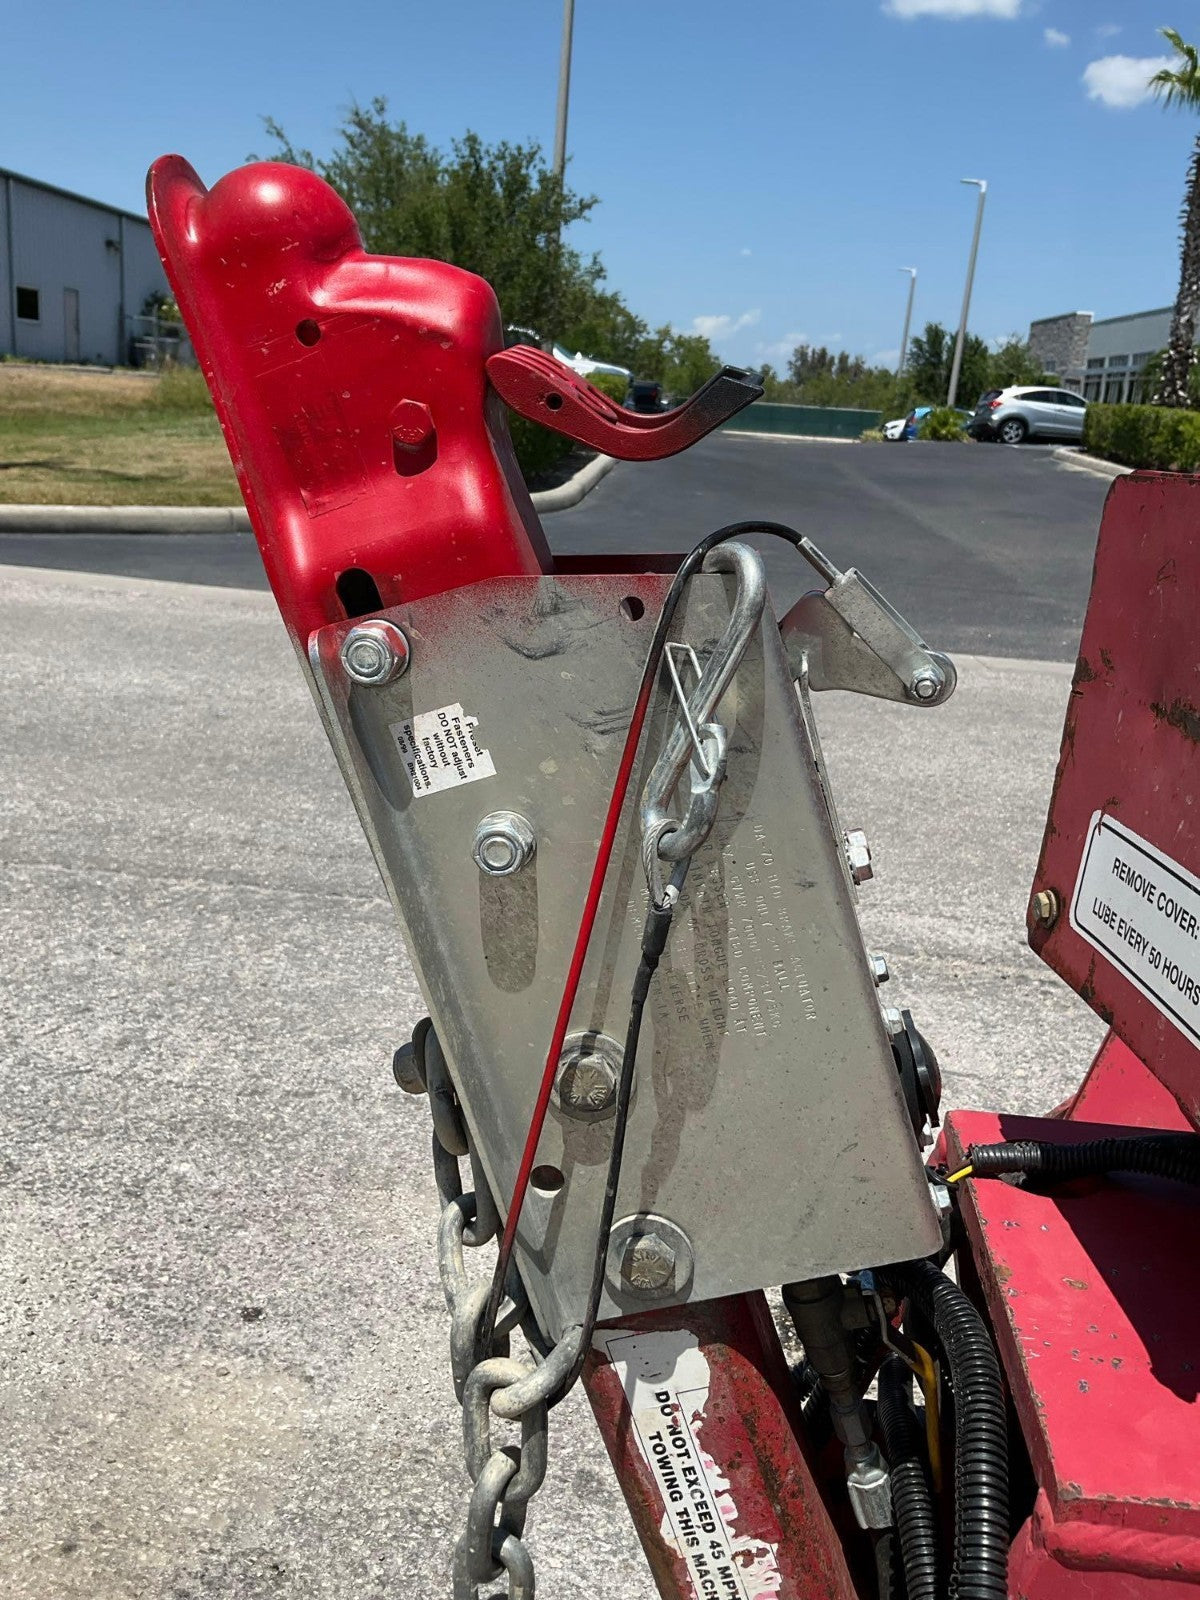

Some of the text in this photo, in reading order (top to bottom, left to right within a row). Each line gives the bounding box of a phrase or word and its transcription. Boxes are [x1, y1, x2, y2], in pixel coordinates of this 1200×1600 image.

[404, 724, 432, 789] specifications.
[422, 737, 438, 768] factory
[433, 732, 450, 766] without
[438, 712, 468, 780] DO NOT adjust
[452, 717, 474, 768] Fasteners
[1112, 856, 1200, 940] REMOVE COVER:
[773, 960, 790, 991] BALL
[1092, 897, 1200, 1006] LUBE EVERY 50 HOURS
[664, 966, 688, 1022] REVERSE
[738, 966, 766, 1036] COMPONENT
[790, 955, 817, 1019] ACTUATOR
[648, 1431, 684, 1503] TOWING
[676, 1506, 700, 1548] THIS
[654, 1390, 672, 1418] DO
[666, 1423, 692, 1462] NOT
[682, 1466, 716, 1534] EXCEED
[708, 1540, 726, 1560] 45
